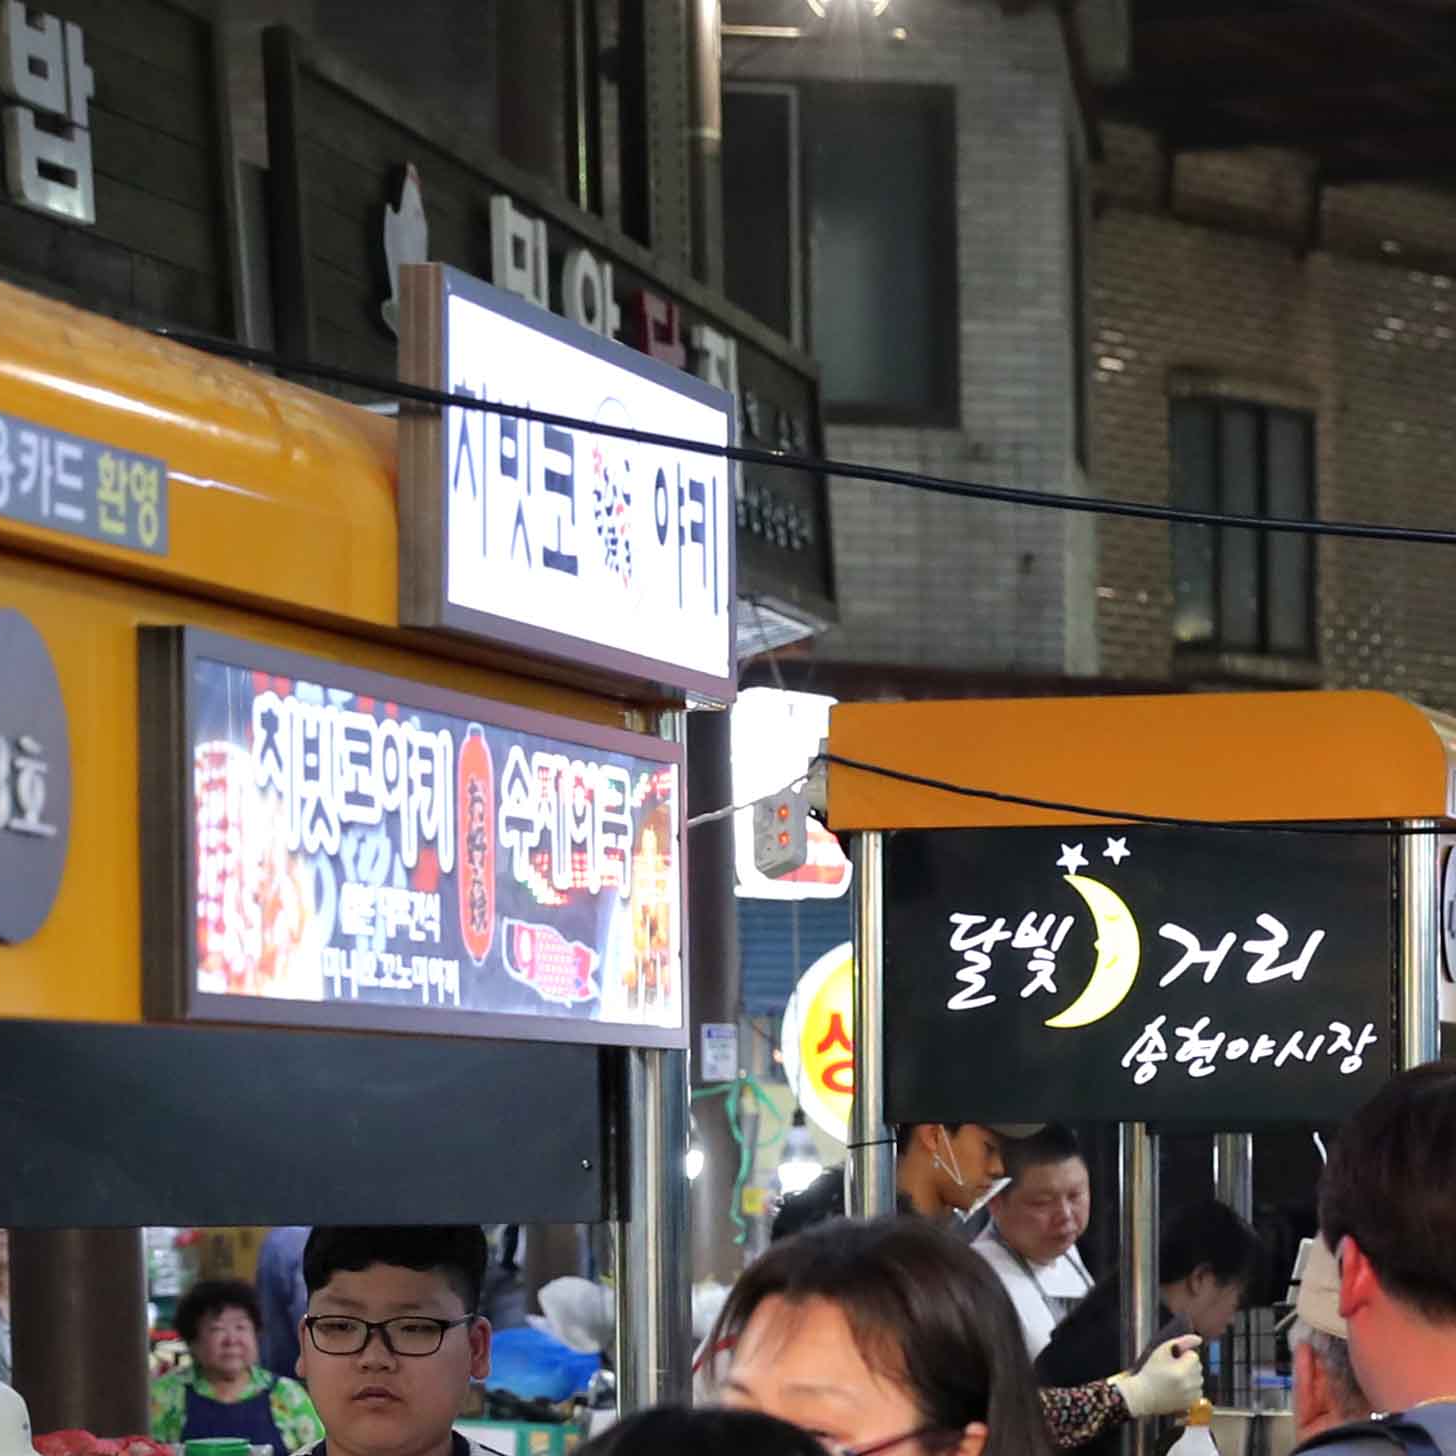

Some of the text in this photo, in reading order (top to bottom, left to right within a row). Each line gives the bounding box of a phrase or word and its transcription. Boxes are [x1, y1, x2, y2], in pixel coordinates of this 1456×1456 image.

[97, 452, 159, 547] 환영
[251, 690, 455, 874] 치빗코야키
[946, 911, 1327, 1011] 달빛 거리
[1121, 1015, 1378, 1085] 송현야시장
